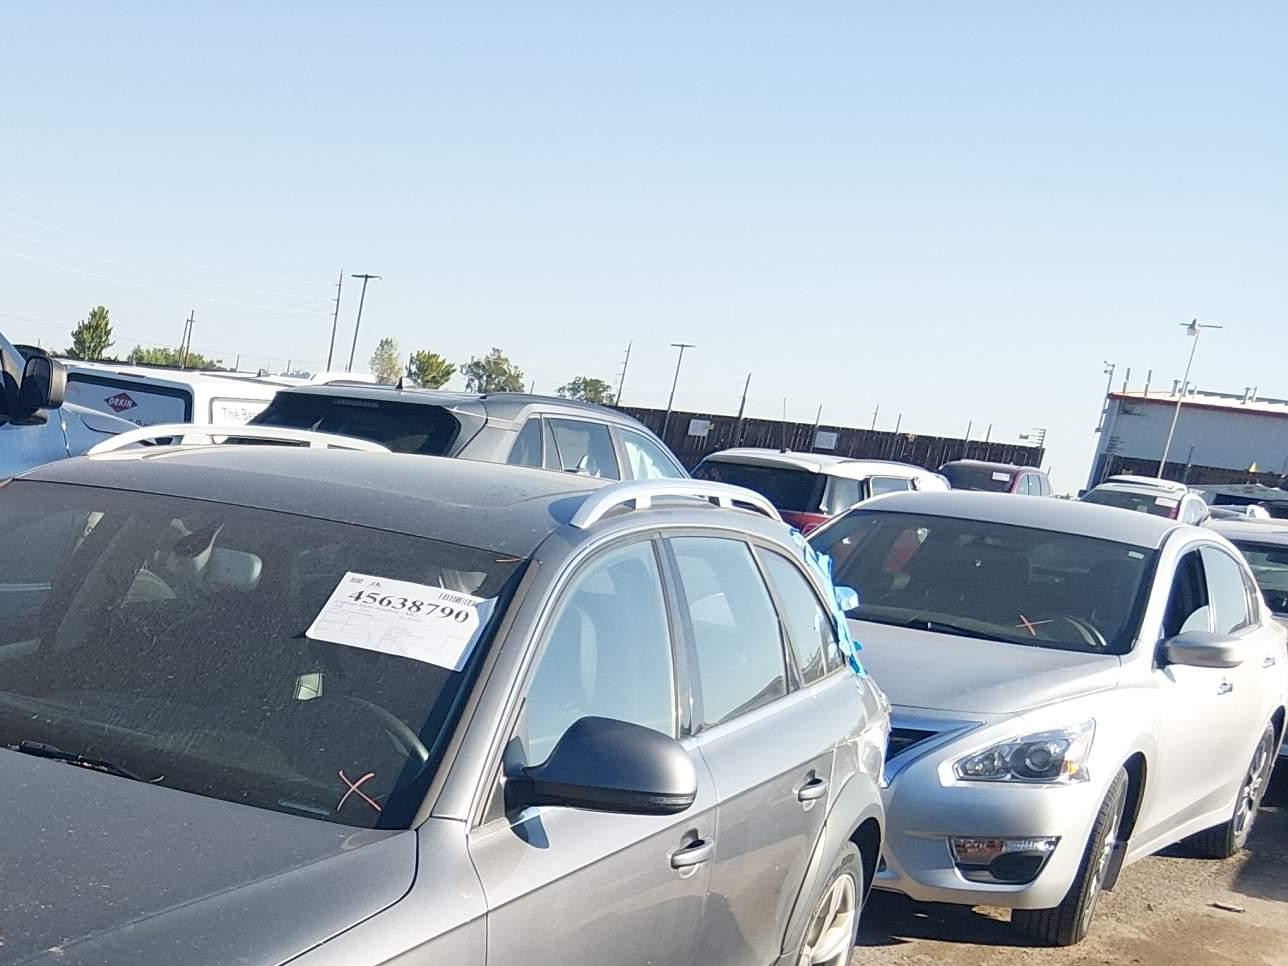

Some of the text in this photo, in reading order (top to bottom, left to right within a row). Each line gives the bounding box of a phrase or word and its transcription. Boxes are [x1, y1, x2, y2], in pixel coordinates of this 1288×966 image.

[108, 397, 133, 409] ORKIN
[221, 407, 240, 421] The
[348, 590, 470, 624] 45638790
